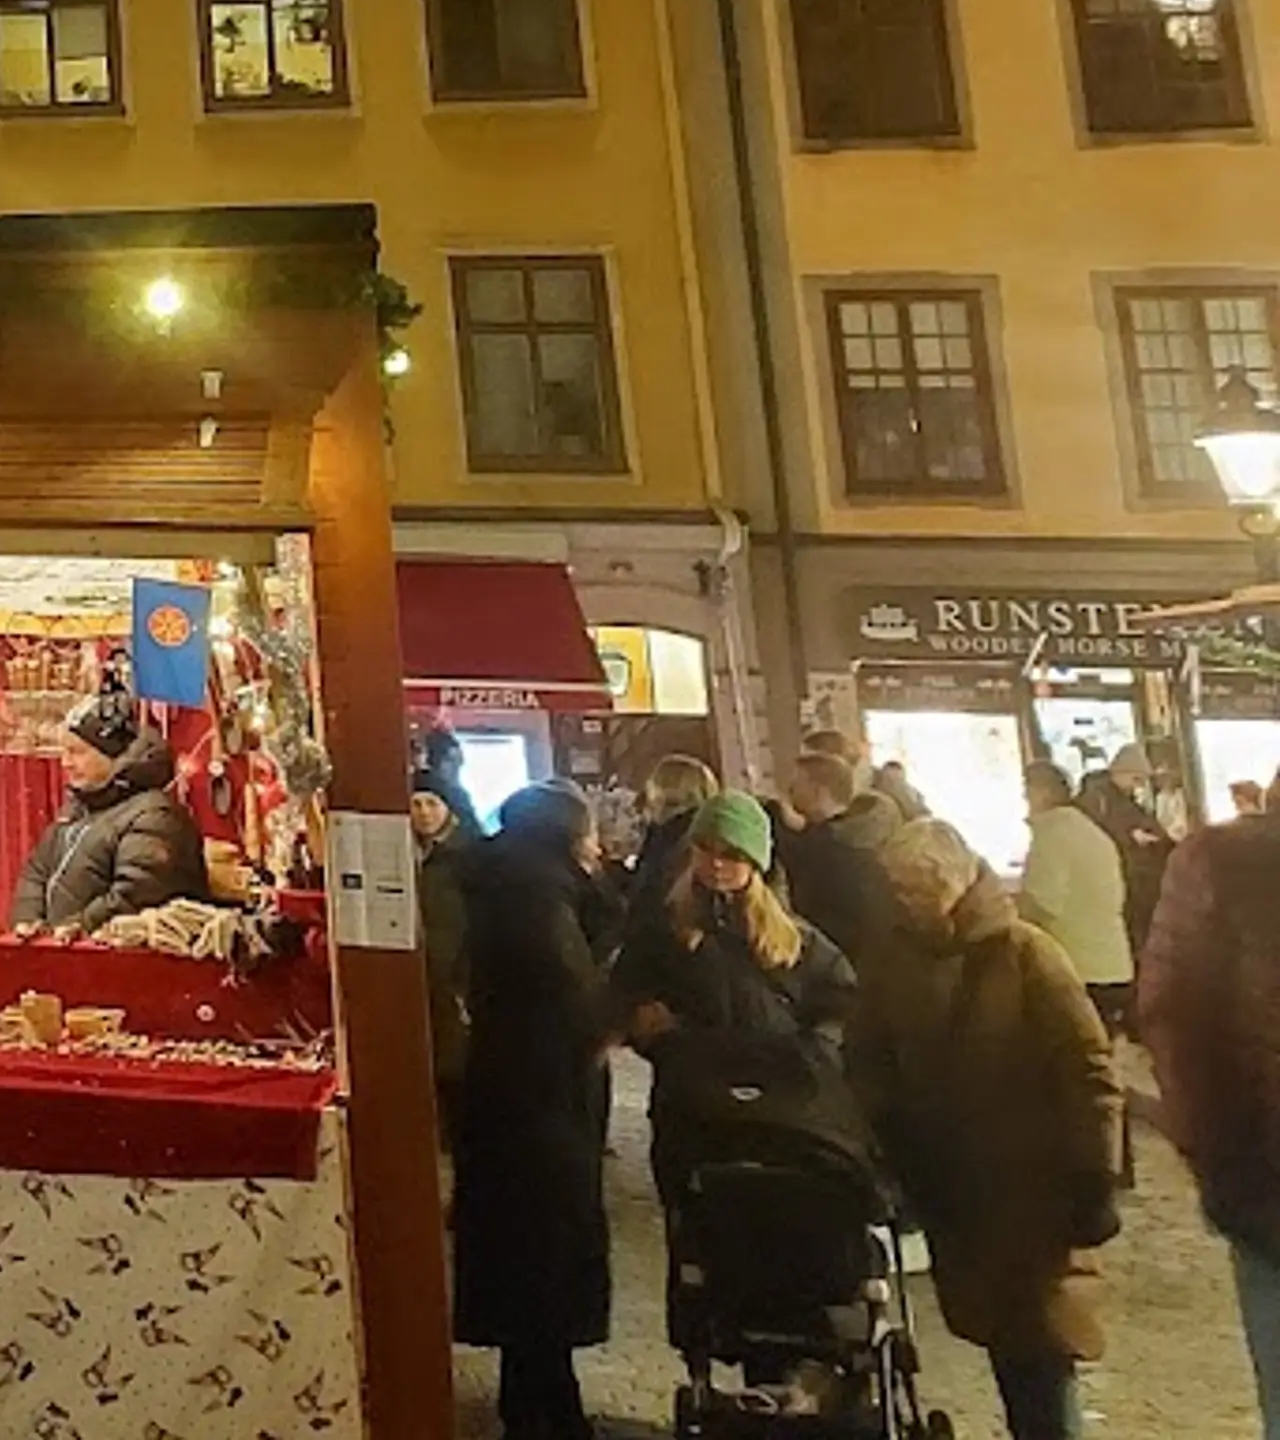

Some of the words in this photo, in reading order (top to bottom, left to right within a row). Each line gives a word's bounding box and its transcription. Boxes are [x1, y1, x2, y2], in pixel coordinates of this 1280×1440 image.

[933, 599, 1265, 638] RUNSTE
[1057, 637, 1149, 658] HORSE
[441, 689, 539, 708] PIZZERIA
